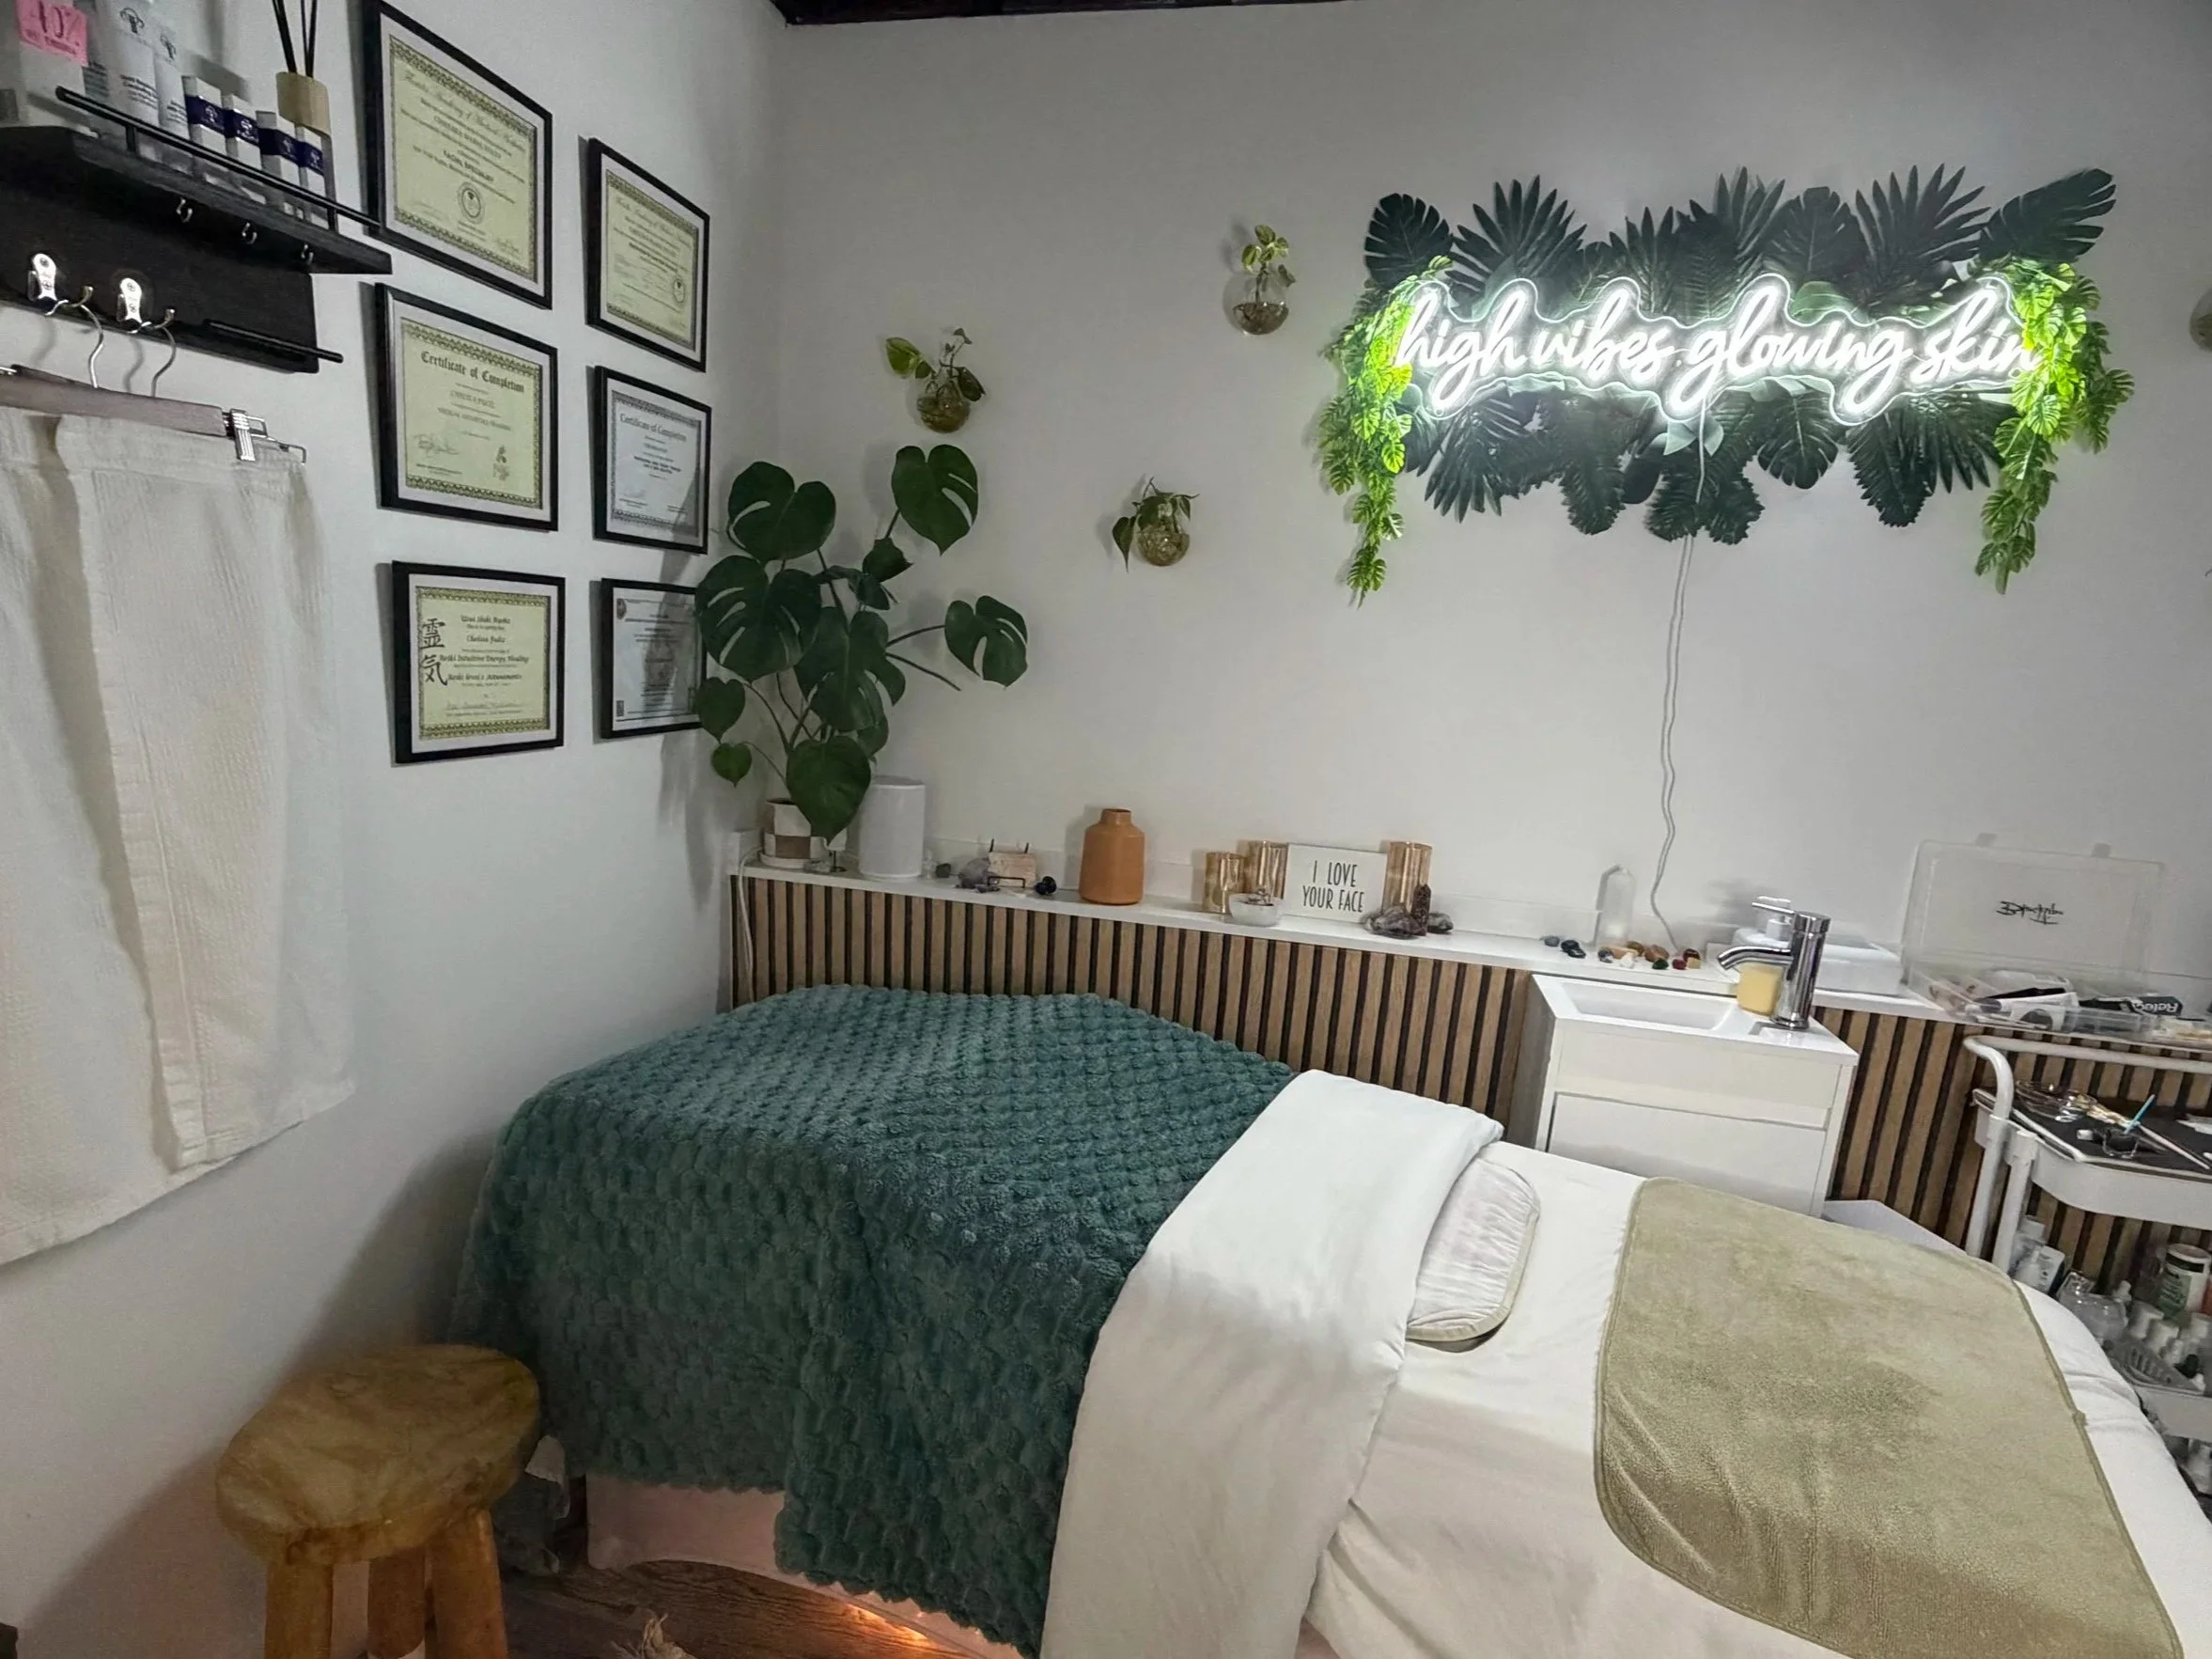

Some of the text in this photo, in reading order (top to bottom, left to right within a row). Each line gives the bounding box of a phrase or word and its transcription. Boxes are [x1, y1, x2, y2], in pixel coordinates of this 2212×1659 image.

[1394, 285, 2041, 414] high vibes glowing skin
[420, 351, 466, 375] Certificate
[470, 368, 478, 380] of
[1313, 860, 1358, 887] I LOVE
[1302, 885, 1364, 913] YOUR FACE
